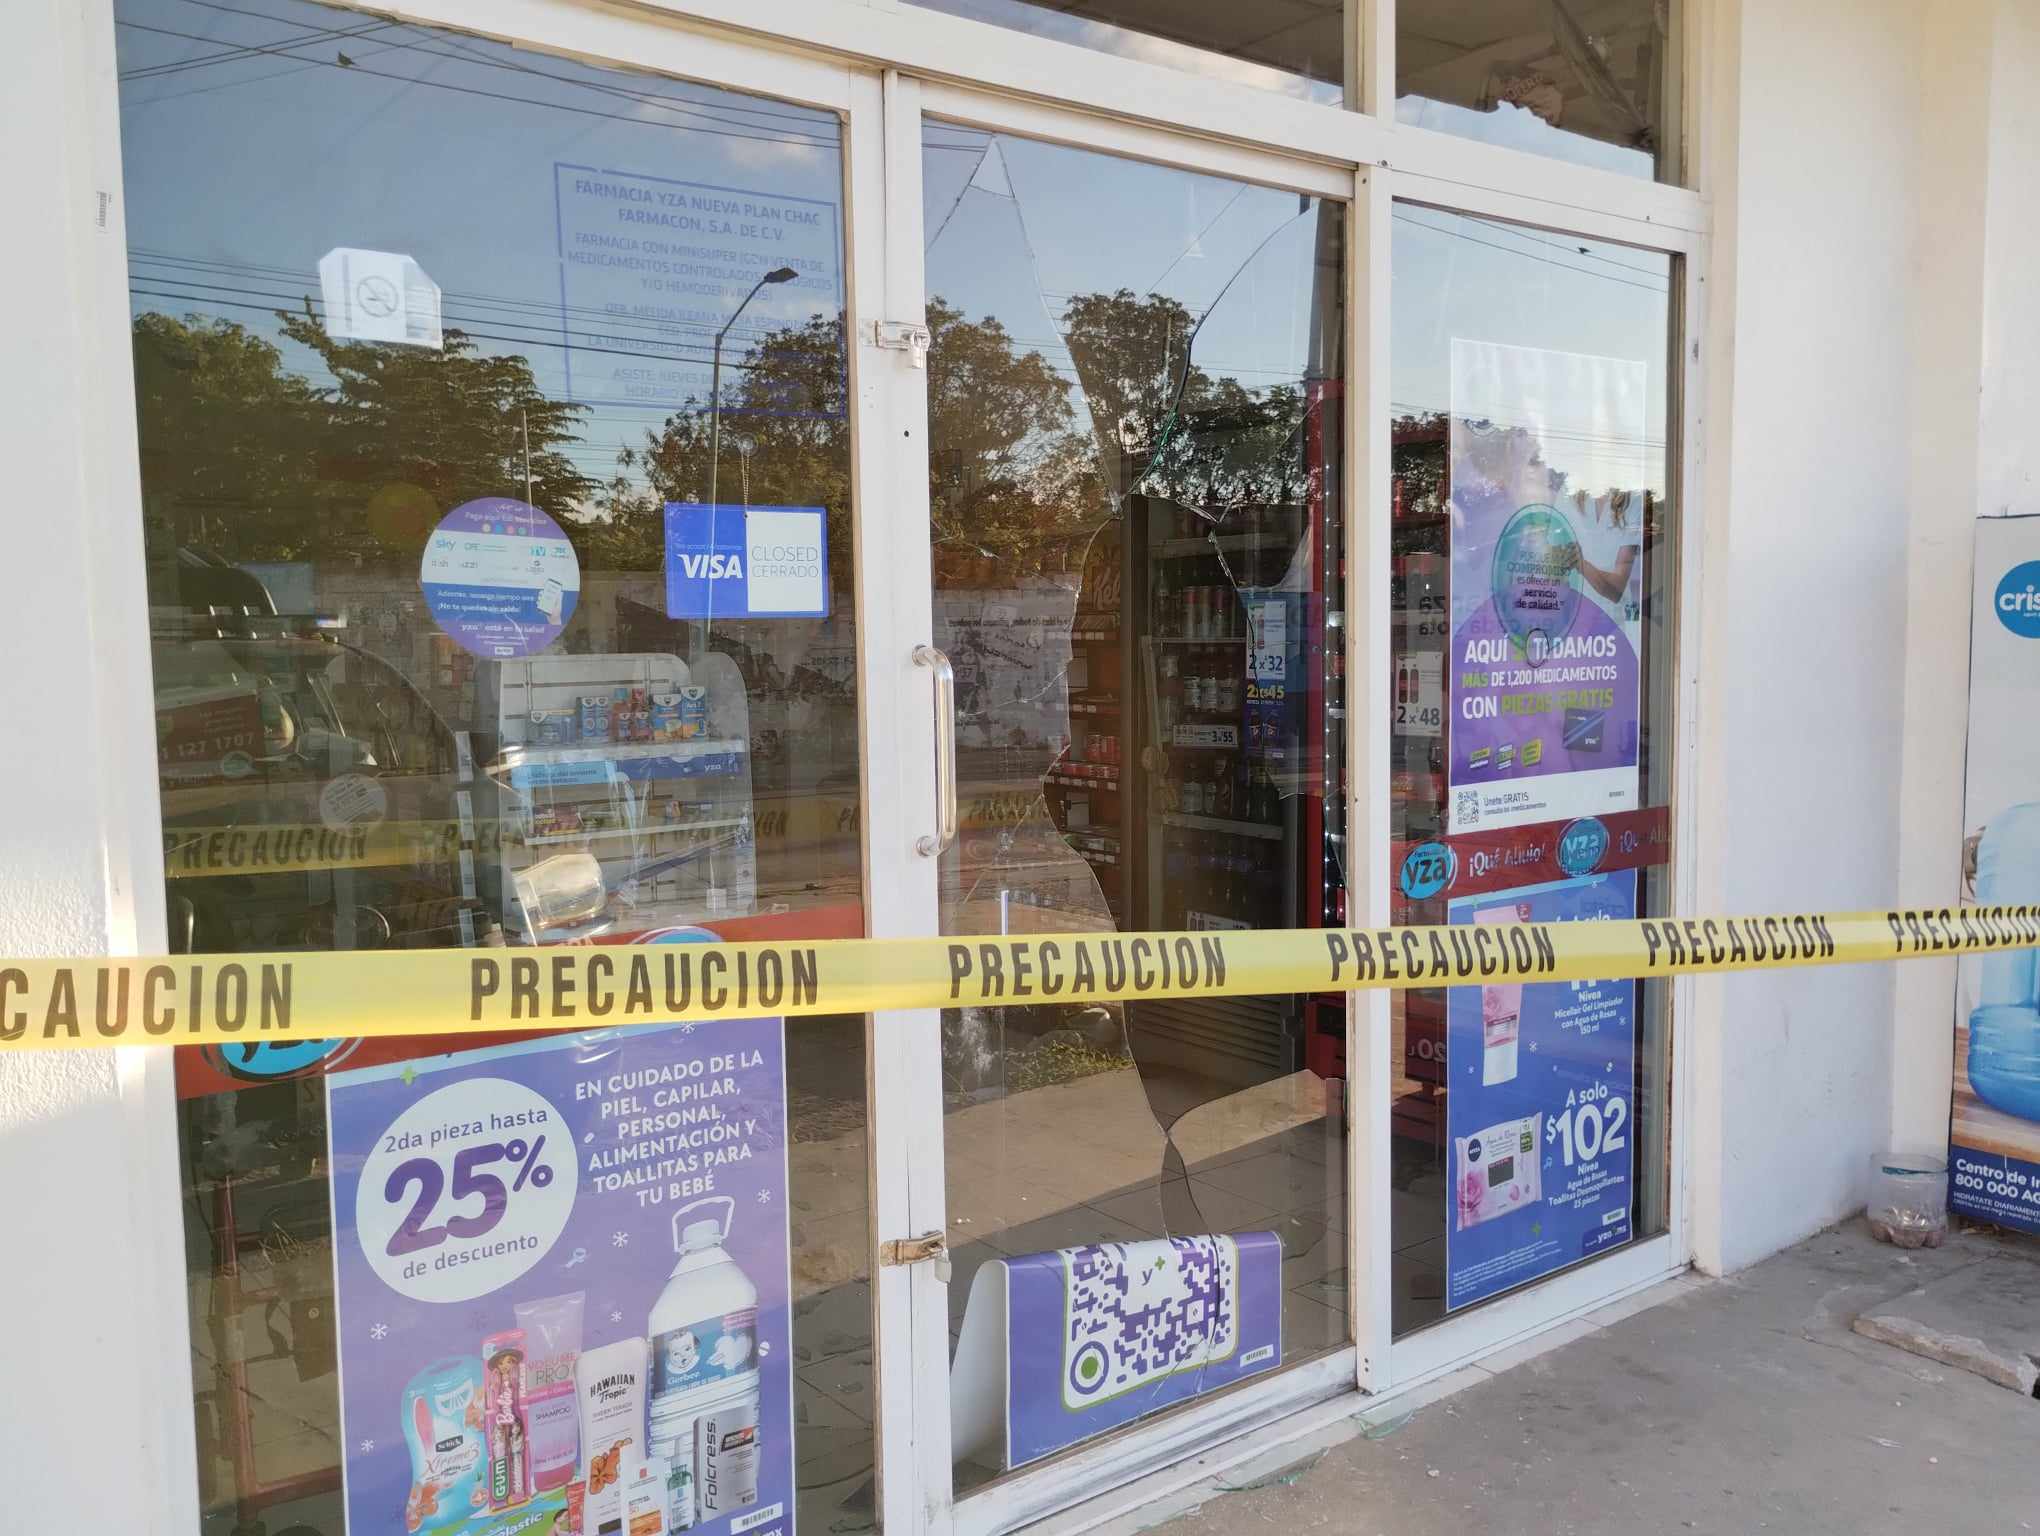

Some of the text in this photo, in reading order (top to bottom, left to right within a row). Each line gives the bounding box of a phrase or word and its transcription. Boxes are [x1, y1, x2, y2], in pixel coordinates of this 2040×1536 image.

[575, 180, 821, 226] FARMACIA YZA NUEVA PLAN CHAC
[676, 554, 744, 579] VISA
[751, 546, 818, 562] CLOSED
[751, 565, 819, 578] CERRADO
[1464, 635, 1509, 664] AQUÍ
[1491, 670, 1505, 687] DE
[1534, 665, 1617, 685] MEDICAMENTOS
[1462, 696, 1497, 719] CON
[470, 949, 819, 1020] PRECAUCION
[947, 936, 1227, 999] PRECAUCION
[1326, 926, 1556, 982] PRECAUCION
[1642, 915, 1835, 967] PRECAUCION
[575, 1049, 764, 1101] EN CUIDADO DE LA
[600, 1079, 742, 1120] PIEL, CAPILAR,
[1565, 1081, 1608, 1108] A solo
[384, 1106, 549, 1155] 2da pieza hasta
[618, 1106, 728, 1140] PERSONAL,
[1545, 1097, 1627, 1167] $102
[588, 1118, 757, 1172] ALIMENTACIÓN Y
[593, 1143, 753, 1194] TOALLITAS PARA
[1955, 1173, 1984, 1190] 800
[1986, 1181, 2019, 1198] 000
[1956, 1158, 2004, 1180] Centro
[2007, 1170, 2027, 1186] de
[384, 1134, 554, 1258] 25%
[636, 1170, 716, 1207] TU BEBÉ
[402, 1232, 540, 1280] de descuento
[590, 1373, 636, 1398] HAWAIIAN
[535, 1407, 570, 1420] SHAMPOO
